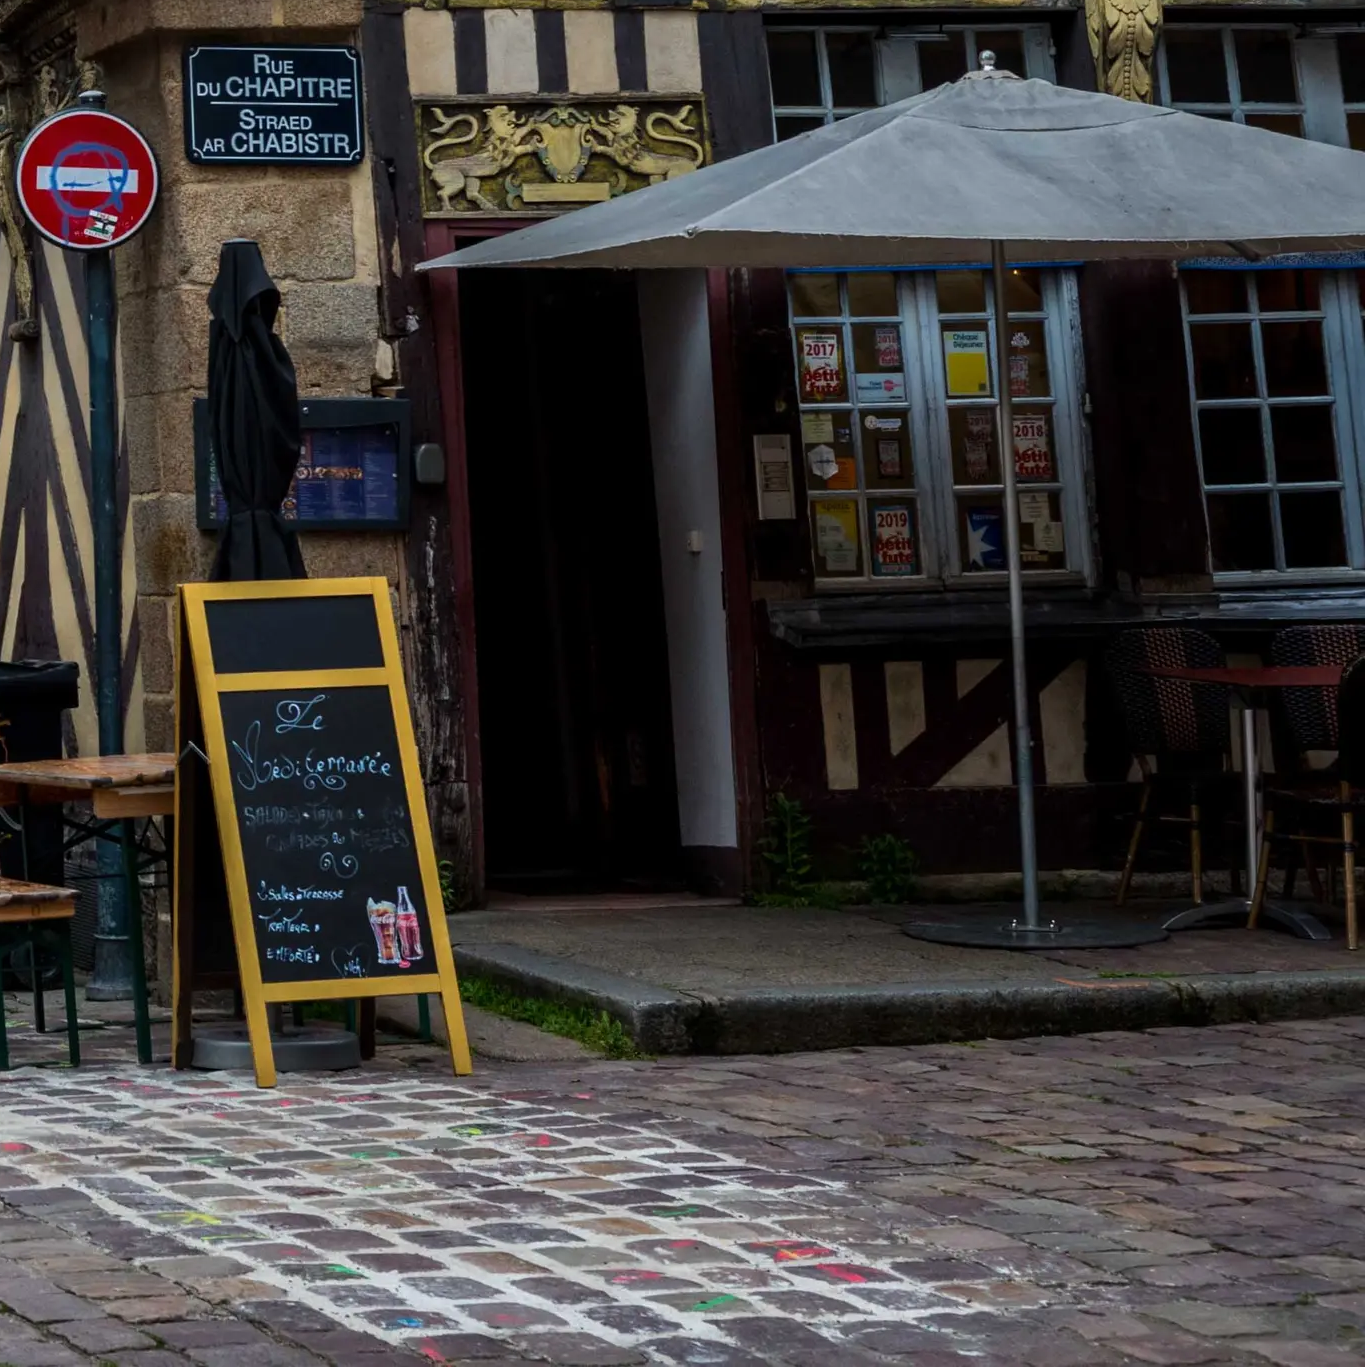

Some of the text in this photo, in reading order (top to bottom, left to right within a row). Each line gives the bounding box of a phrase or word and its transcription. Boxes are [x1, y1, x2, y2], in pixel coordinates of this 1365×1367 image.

[196, 76, 353, 99] DU CHAPITRE
[202, 132, 350, 154] AR CHABISTR
[805, 343, 835, 357] 2017
[1014, 425, 1043, 437] 2018
[876, 512, 908, 528] 2019
